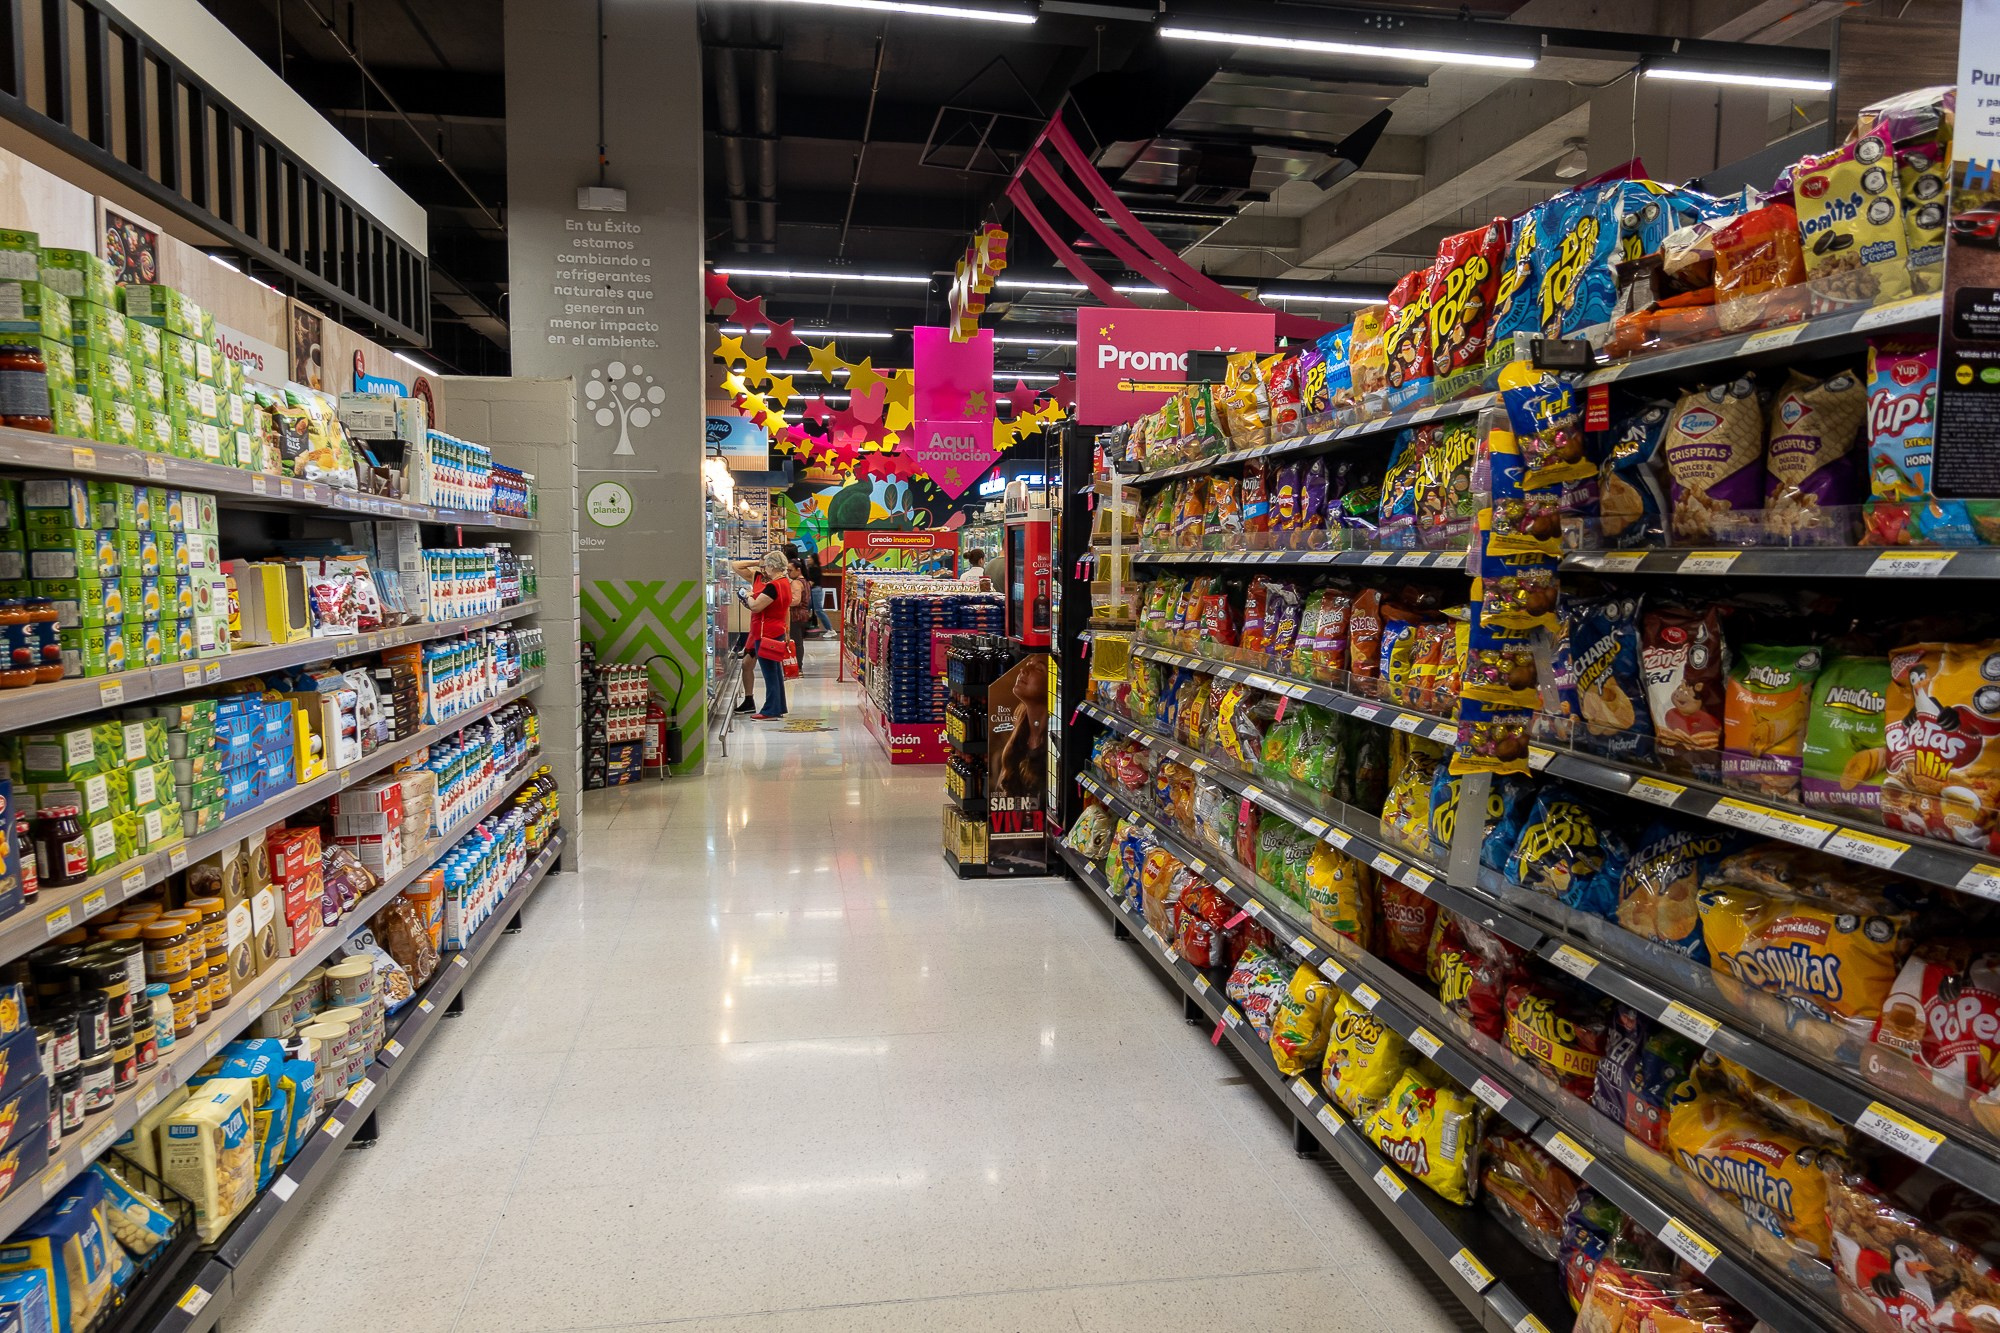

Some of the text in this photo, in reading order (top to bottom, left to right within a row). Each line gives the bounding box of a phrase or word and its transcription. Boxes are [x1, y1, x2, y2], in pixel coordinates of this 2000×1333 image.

[1804, 179, 1823, 192] Yupi
[565, 218, 641, 234] En tu Éxito
[573, 237, 634, 251] estamos
[1860, 241, 1895, 256] Cookies
[557, 252, 651, 267] cambiando a
[1868, 249, 1897, 263] Cream
[556, 268, 652, 284] refrigerantes
[554, 284, 654, 302] naturales que
[564, 302, 645, 316] generan un
[1564, 288, 1586, 331] NATURAL
[550, 318, 659, 335] menor impacto
[548, 332, 659, 348] en el ambiente.
[1459, 335, 1482, 361] BBQ
[1409, 355, 1424, 376] BBQ
[1897, 363, 1919, 378] Yupi
[1536, 391, 1573, 421] Jet
[1681, 415, 1717, 434] Ramo
[928, 432, 976, 453] Aqui
[1772, 438, 1816, 453] CRISPETAS
[917, 449, 991, 463] promoción
[1668, 446, 1728, 463] CRISPETAS
[1779, 456, 1800, 465] DULCES
[1679, 464, 1705, 473] DULCES
[1524, 492, 1559, 502] Burbujas
[593, 505, 626, 517] planeta
[578, 535, 606, 547] ellow
[871, 536, 931, 545] precio insuperable
[1516, 569, 1552, 578] Burbujas
[1492, 715, 1530, 725] Burbujas
[1855, 720, 1878, 733] Verde
[1461, 745, 1473, 756] 12
[1915, 749, 1954, 782] Mix
[1804, 790, 1826, 802] PARA
[1845, 841, 1874, 854] $4,060
[1534, 1041, 1550, 1058] 12
[1563, 1051, 1600, 1072] PAGU
[1868, 1054, 1880, 1074] 6
[1874, 1117, 1910, 1142] $12,550
[1380, 1136, 1428, 1176] Yupis
